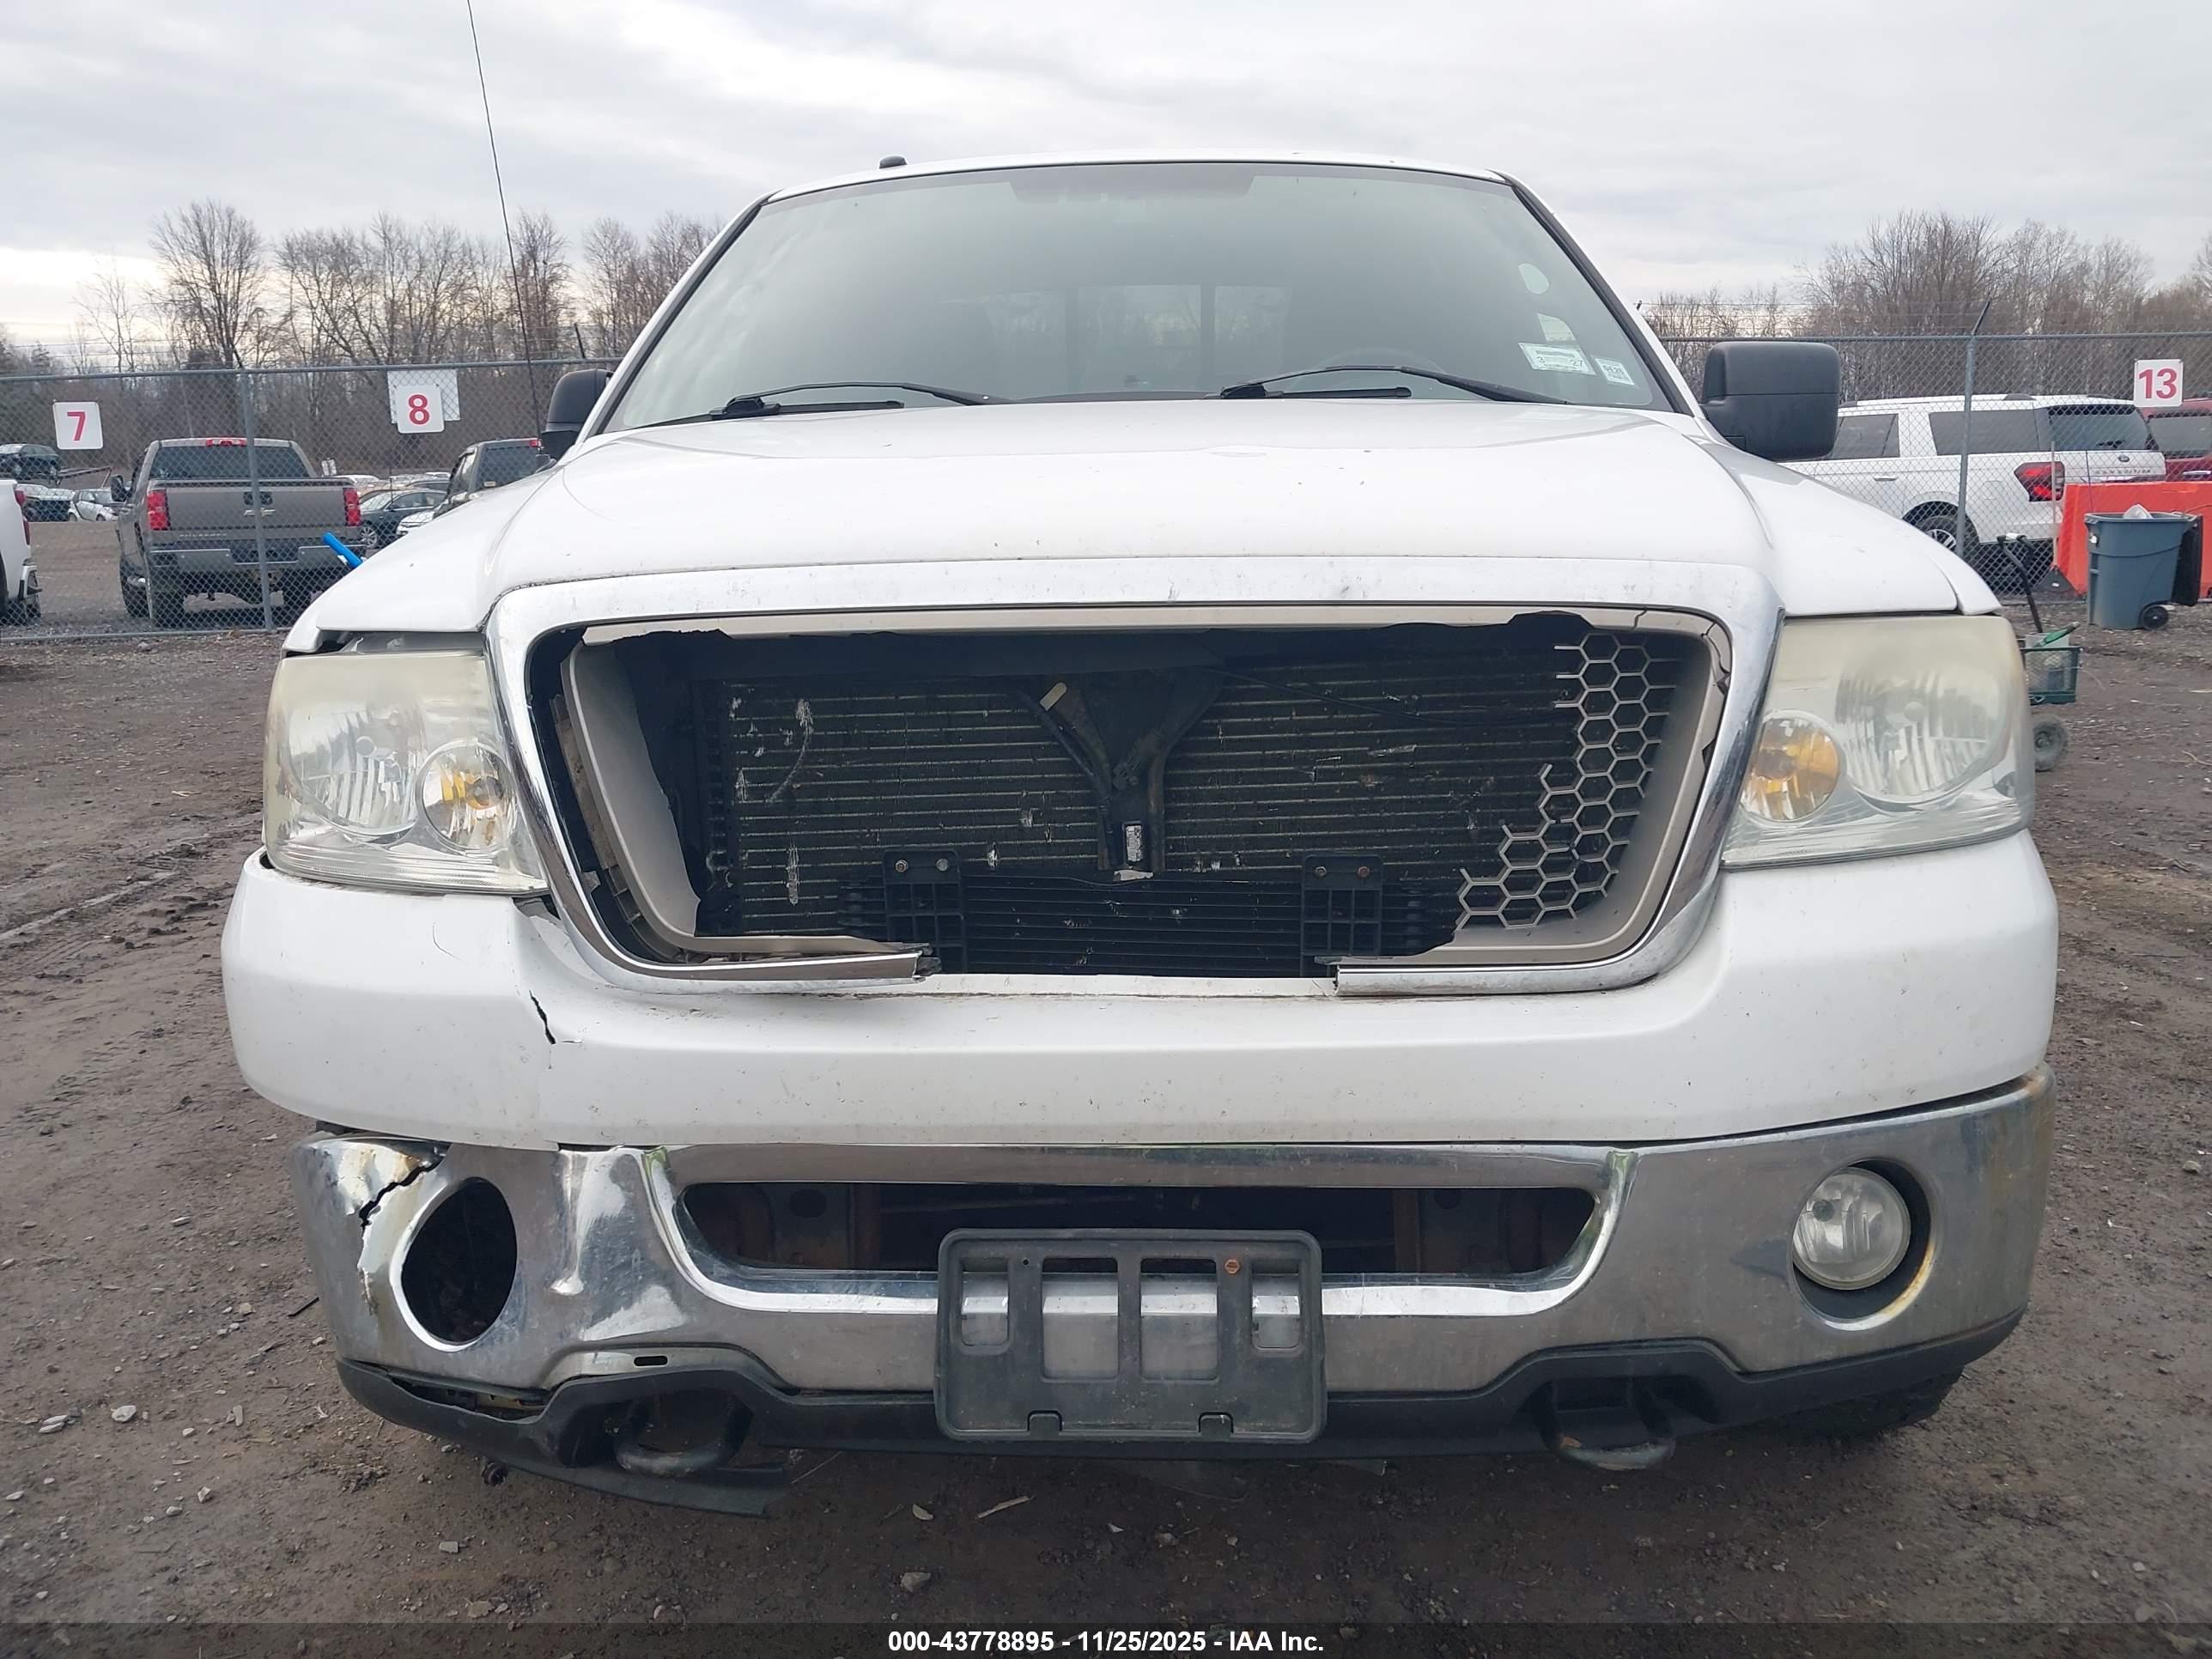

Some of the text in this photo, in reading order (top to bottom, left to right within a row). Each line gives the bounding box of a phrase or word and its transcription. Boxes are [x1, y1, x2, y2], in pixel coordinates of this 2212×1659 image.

[2139, 368, 2177, 399] 13
[408, 394, 430, 425] 8
[67, 411, 86, 441] 7
